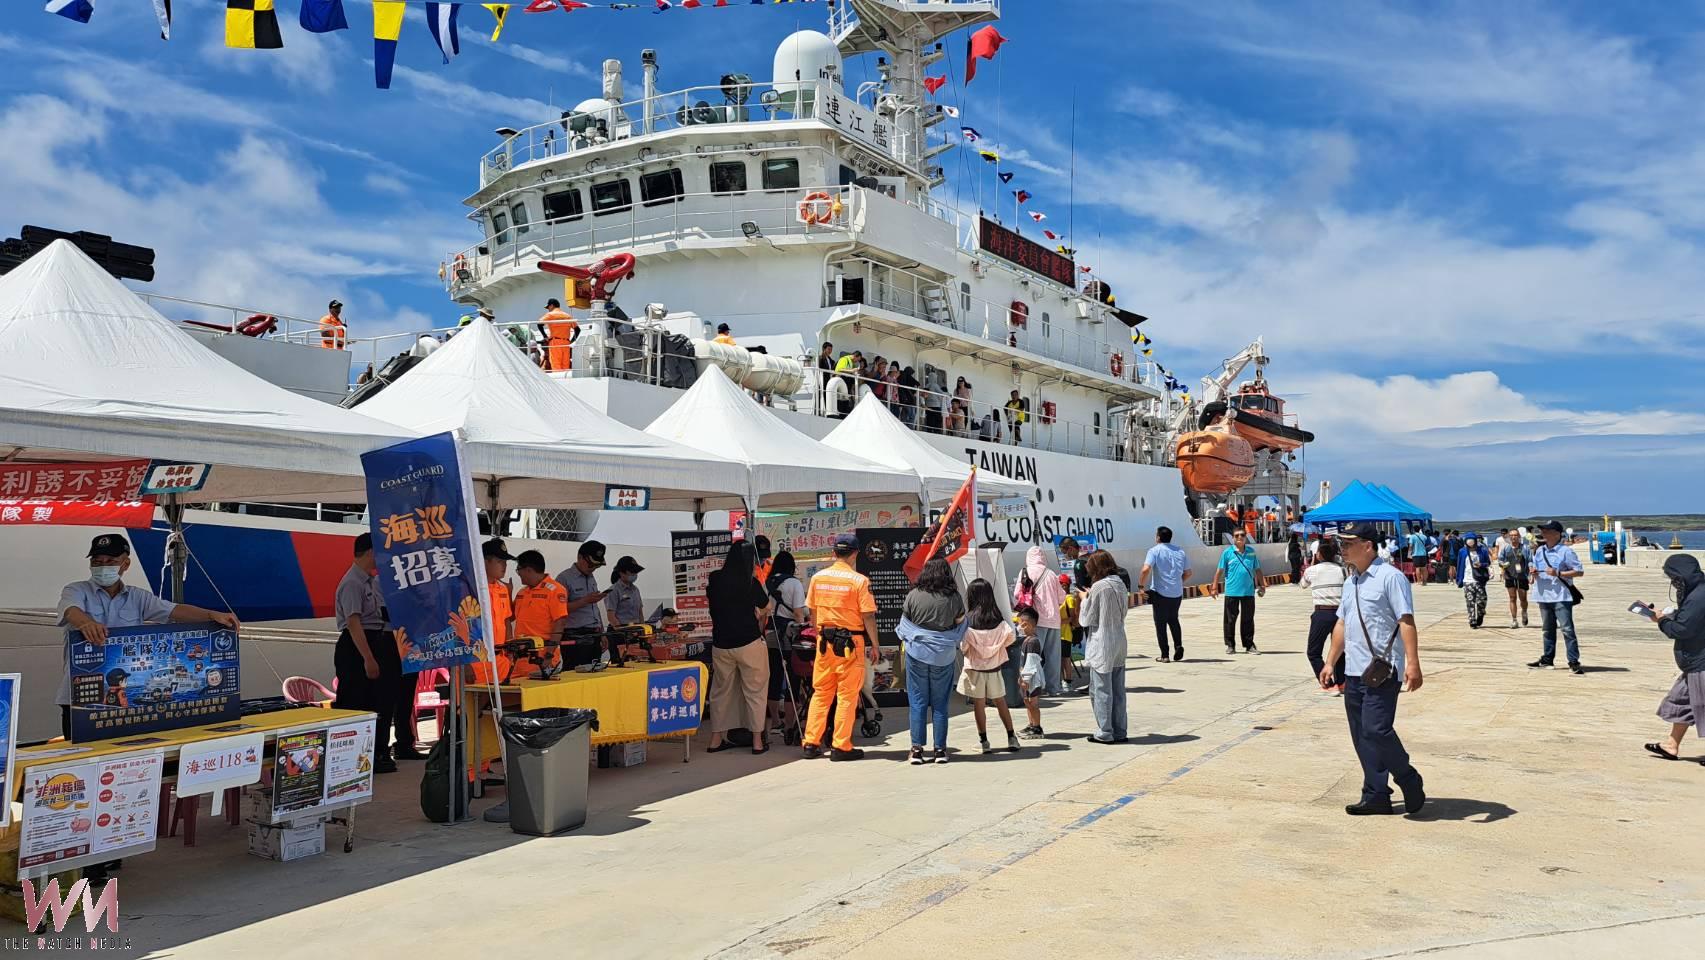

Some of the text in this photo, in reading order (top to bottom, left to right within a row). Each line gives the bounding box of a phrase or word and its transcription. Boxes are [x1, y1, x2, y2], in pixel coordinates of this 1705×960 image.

[825, 95, 888, 148] 連江艦
[381, 464, 444, 489] COAST GUARD
[965, 448, 1038, 484] TAIWAN
[379, 504, 454, 549] 海巡
[1007, 515, 1062, 543] COAST
[1066, 517, 1114, 543] GUARD
[390, 546, 463, 590] 招募
[650, 685, 679, 700] 海巡署
[651, 703, 698, 722] 第七岸巡隊
[185, 752, 242, 775] 海巡118
[36, 779, 86, 798] 非洲豬瘟
